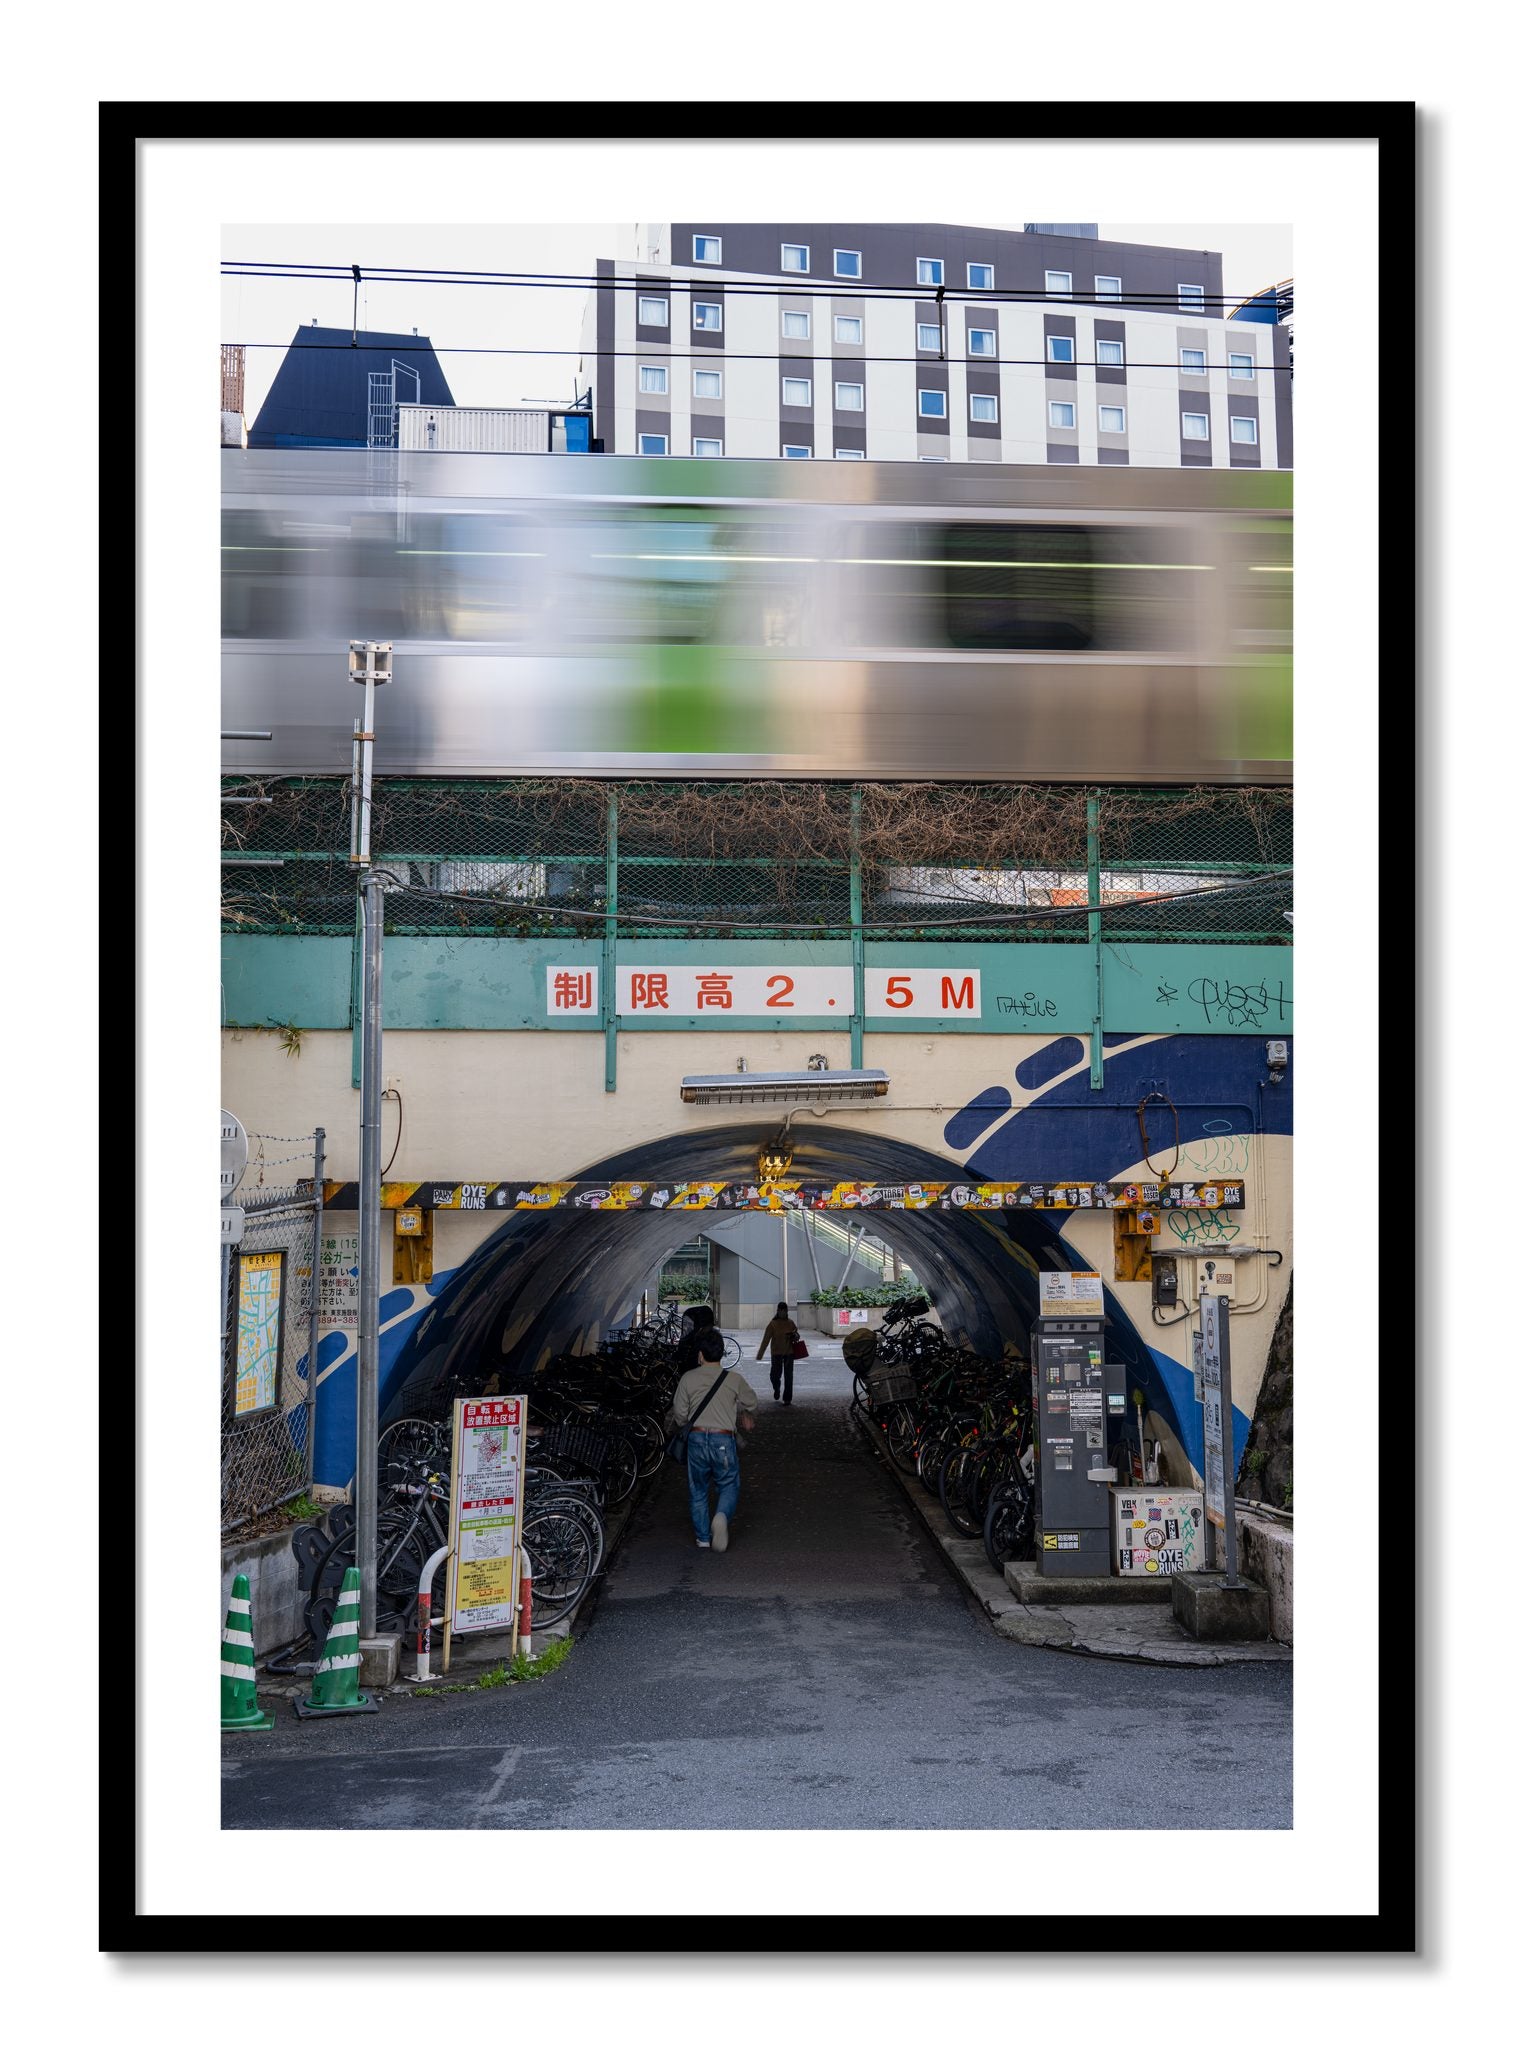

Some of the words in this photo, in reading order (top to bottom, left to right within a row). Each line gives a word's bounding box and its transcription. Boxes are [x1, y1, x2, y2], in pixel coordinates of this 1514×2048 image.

[461, 1184, 487, 1197] OYE
[1223, 1187, 1240, 1195] OYE
[460, 1197, 486, 1210] RUNS
[466, 1413, 517, 1427] 放置禁止区域
[1158, 1549, 1183, 1562] OYE
[1159, 1562, 1183, 1574] RUNS
